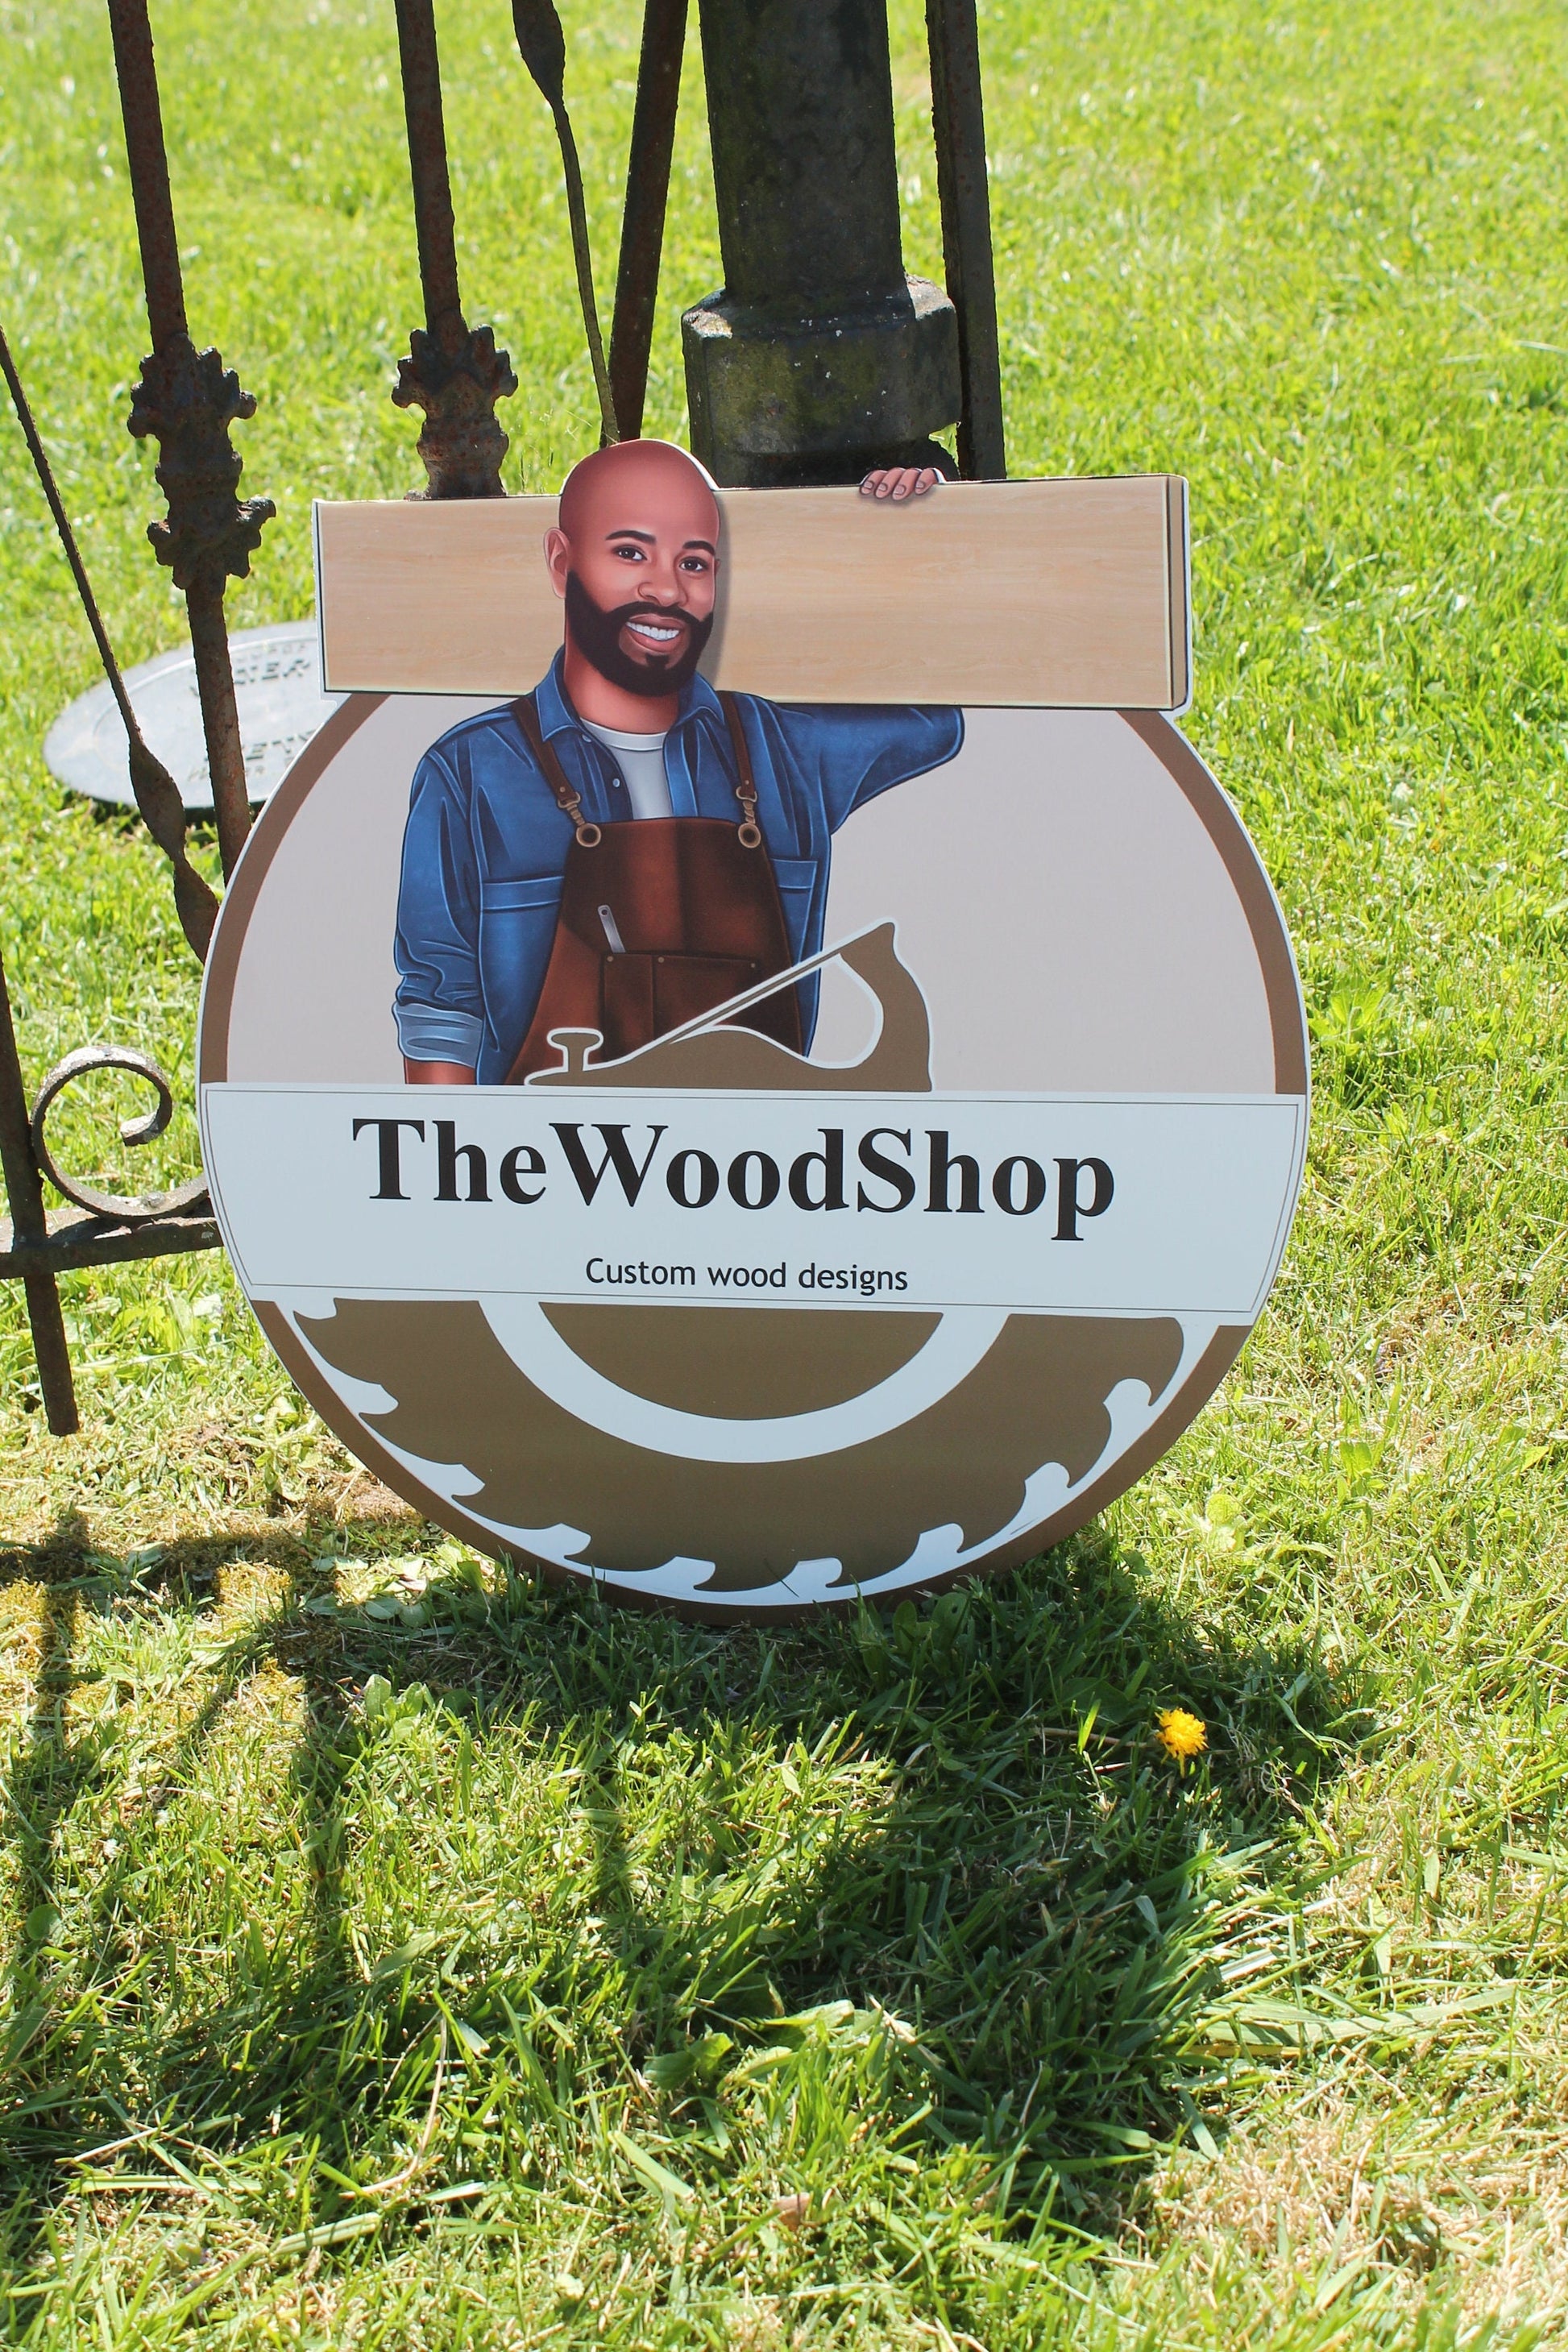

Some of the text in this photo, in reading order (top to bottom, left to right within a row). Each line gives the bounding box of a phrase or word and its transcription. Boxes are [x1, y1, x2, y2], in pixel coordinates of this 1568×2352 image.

[352, 1118, 1115, 1242] TheWoodShop
[586, 1257, 909, 1297] Custom wood designs
